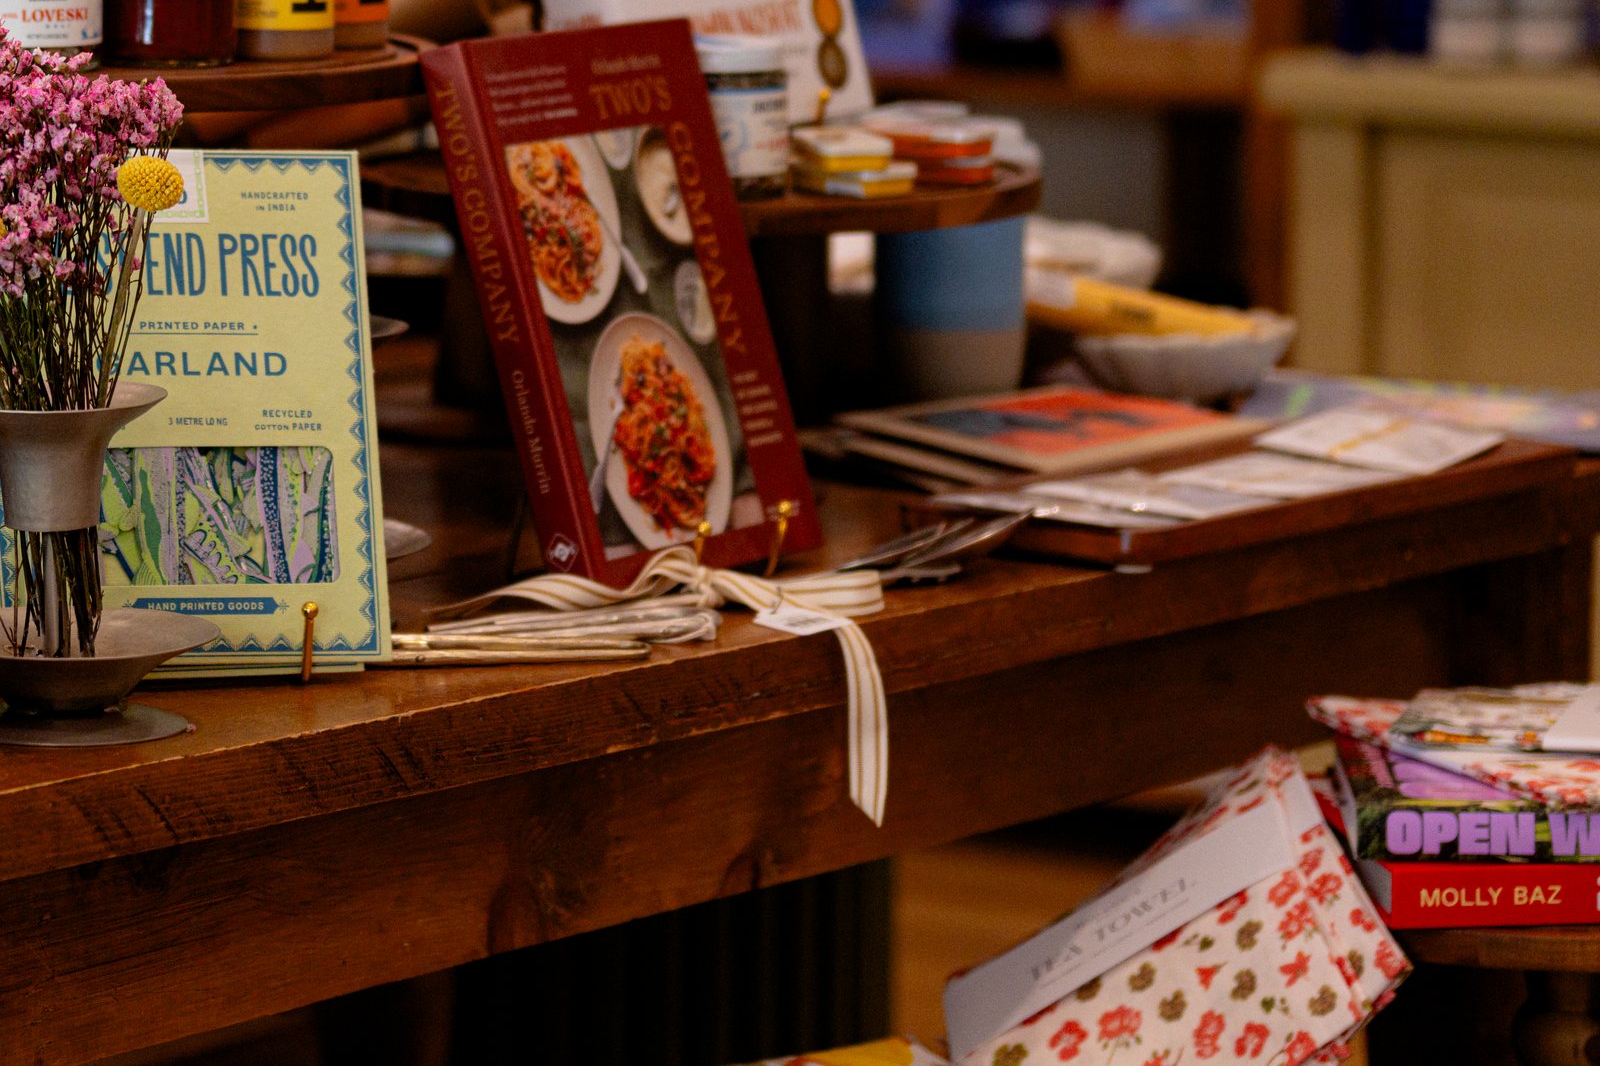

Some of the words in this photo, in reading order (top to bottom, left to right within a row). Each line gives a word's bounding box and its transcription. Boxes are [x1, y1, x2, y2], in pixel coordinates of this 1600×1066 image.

[22, 7, 89, 23] LOVESKI
[589, 74, 672, 120] TWO'S
[240, 191, 309, 201] HANDCRAFTED
[268, 204, 296, 212] INDIA
[435, 86, 479, 184] TWO'S
[463, 189, 520, 343] COMPANY
[669, 121, 748, 355] COMPANY
[145, 232, 206, 297] END
[217, 233, 320, 298] PRESS
[139, 321, 199, 331] PRINTED
[203, 321, 245, 331] PAPER
[262, 409, 312, 418] RECYCLED
[168, 417, 174, 426] 3
[175, 417, 204, 427] METRE
[205, 417, 228, 427] LONG
[254, 423, 290, 432] COTTON
[292, 422, 322, 432] PAPER
[147, 602, 176, 611] HAND
[180, 602, 225, 611] PRINTED
[227, 601, 264, 611] GOODS
[1385, 810, 1536, 856] OPEN
[1419, 888, 1503, 908] MOLLY
[1513, 885, 1562, 906] BAZ
